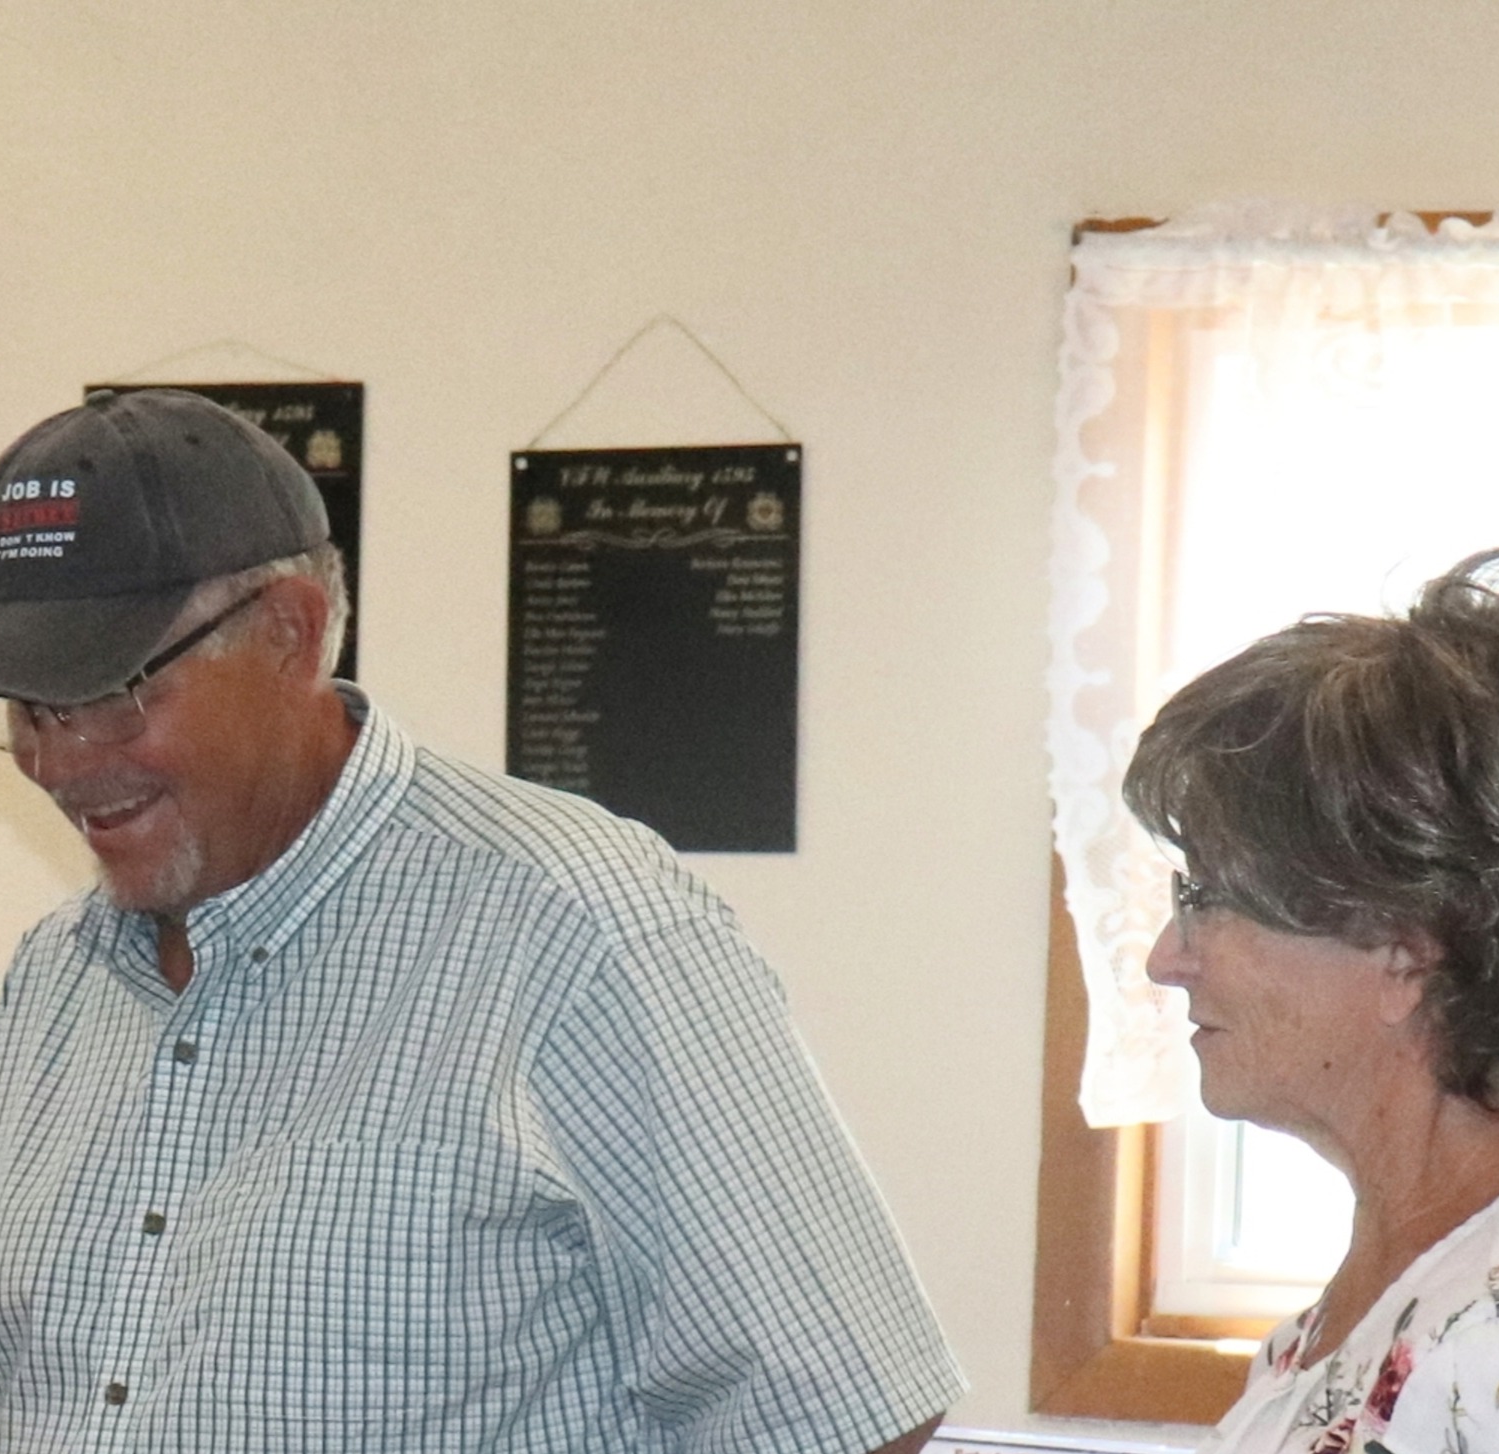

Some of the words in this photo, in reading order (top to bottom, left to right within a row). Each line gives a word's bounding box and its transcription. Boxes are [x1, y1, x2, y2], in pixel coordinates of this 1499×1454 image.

[1, 480, 41, 502] JOB
[49, 479, 77, 499] IS
[35, 531, 76, 543] KNOW
[20, 545, 64, 558] DOING
